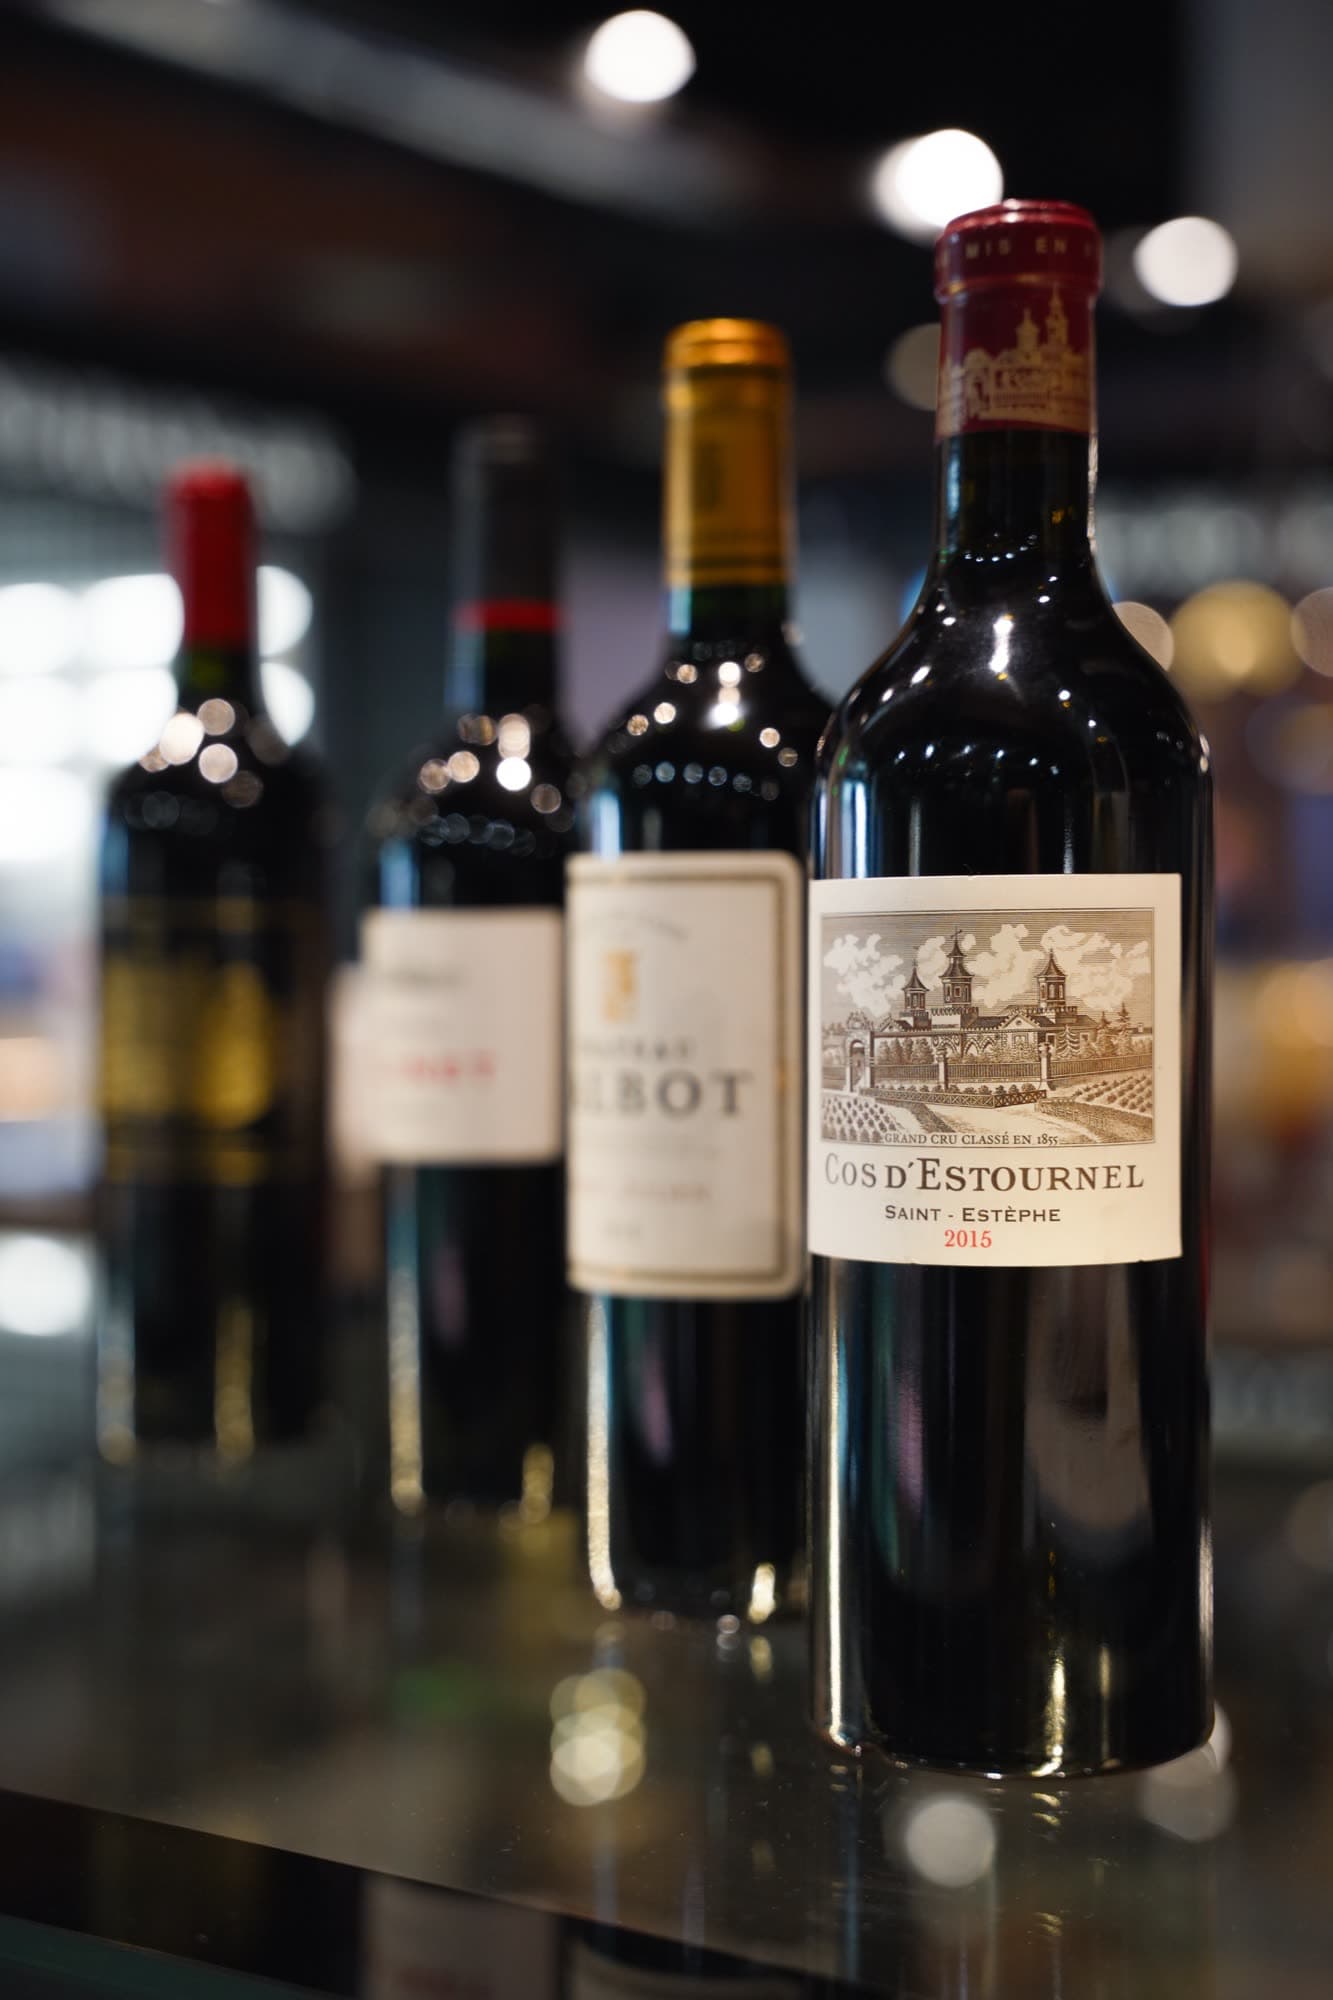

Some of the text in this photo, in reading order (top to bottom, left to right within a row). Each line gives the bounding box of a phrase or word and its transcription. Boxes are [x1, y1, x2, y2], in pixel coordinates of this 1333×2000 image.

[965, 238, 1012, 259] MIS
[1035, 235, 1068, 255] EN
[884, 1130, 1059, 1147] GRAND CRU CLASSÉ EN 1855
[825, 1152, 877, 1188] COS
[885, 1204, 941, 1222] SAINT
[962, 1205, 1061, 1223] ESTÈPHE
[944, 1230, 993, 1248] 2015
